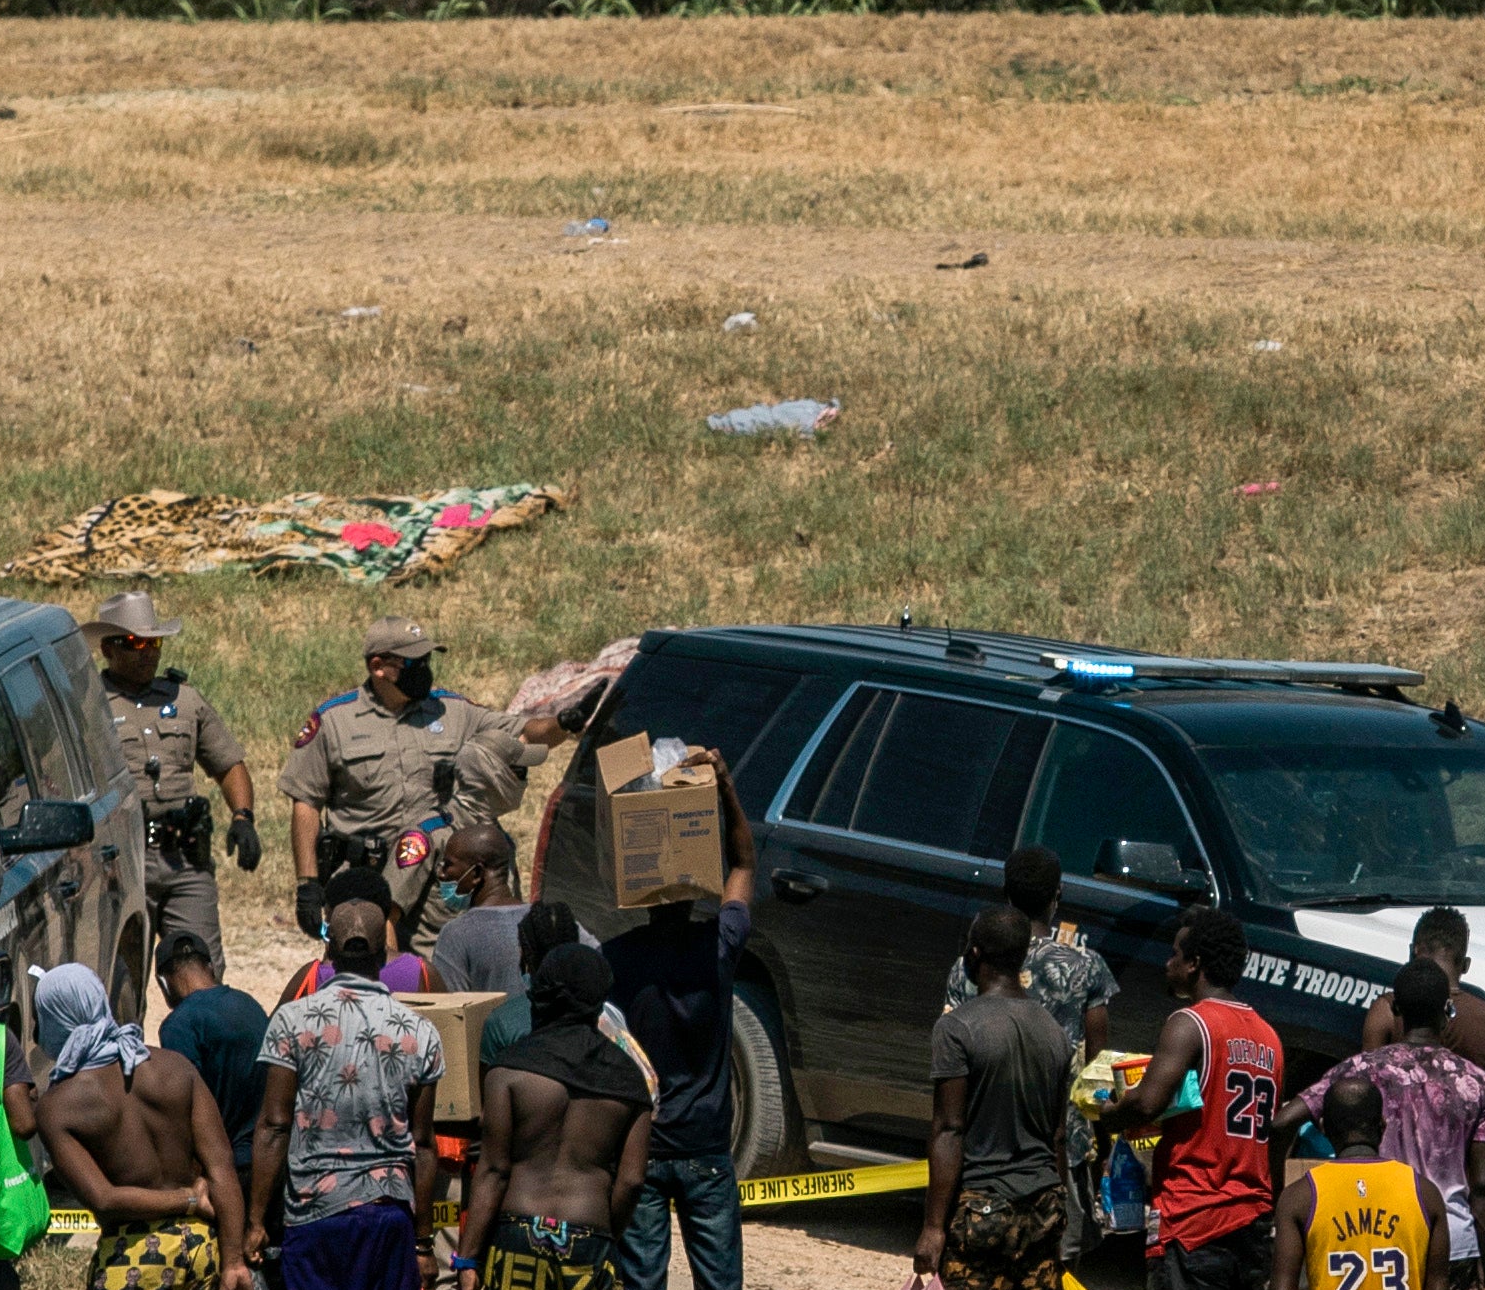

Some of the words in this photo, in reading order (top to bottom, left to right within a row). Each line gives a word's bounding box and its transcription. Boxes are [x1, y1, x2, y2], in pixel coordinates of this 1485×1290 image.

[1051, 926, 1091, 958] TEXAS
[1242, 952, 1291, 986] ATE
[1225, 1069, 1277, 1144] 23
[760, 1179, 788, 1200] LINE
[793, 1172, 855, 1196] SHERIFF'S
[1332, 1208, 1400, 1241] JAMES
